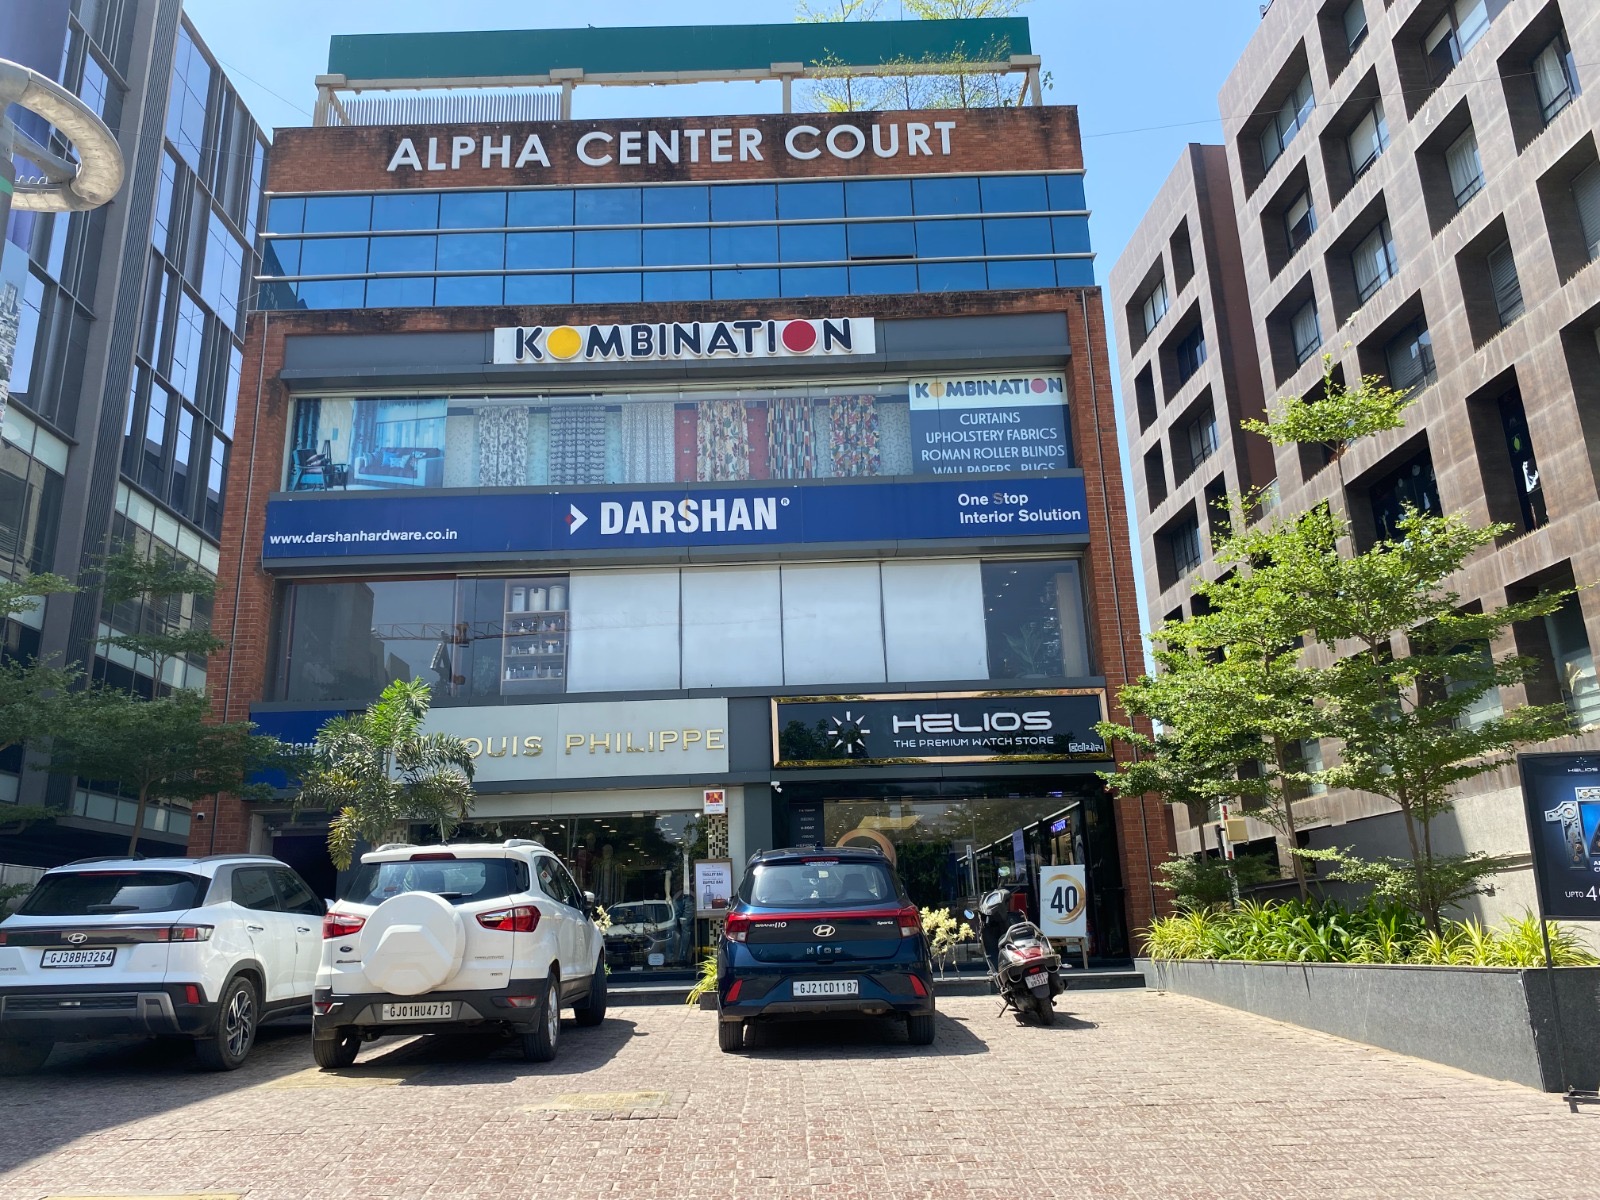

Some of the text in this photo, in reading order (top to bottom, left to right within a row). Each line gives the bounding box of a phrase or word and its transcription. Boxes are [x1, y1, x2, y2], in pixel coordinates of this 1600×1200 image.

[387, 120, 957, 172] ALPHA CENTER COURT
[514, 317, 853, 362] KOMBINATION
[915, 377, 1063, 398] KOMBINATION
[959, 412, 1021, 425] CURTAINS
[925, 428, 1058, 444] UPHOLSTERY FABRICS
[921, 445, 1065, 461] ROMAN ROLLER BLINDS
[957, 492, 1029, 506] One Stop
[600, 497, 778, 535] DARSHAN
[959, 508, 1081, 524] Interior Solution
[269, 528, 458, 545] www.darshanhardware.co.in
[892, 710, 1053, 734] HELIOS
[460, 728, 725, 759] OUIS PHILIPPE
[893, 736, 1054, 748] THE PREMIUM WATCH STORE
[1050, 886, 1078, 914] 40
[50, 951, 113, 963] GJ38BH3264
[799, 981, 858, 994] GJ21CD1187
[389, 1003, 451, 1018] GJ01HU4713
